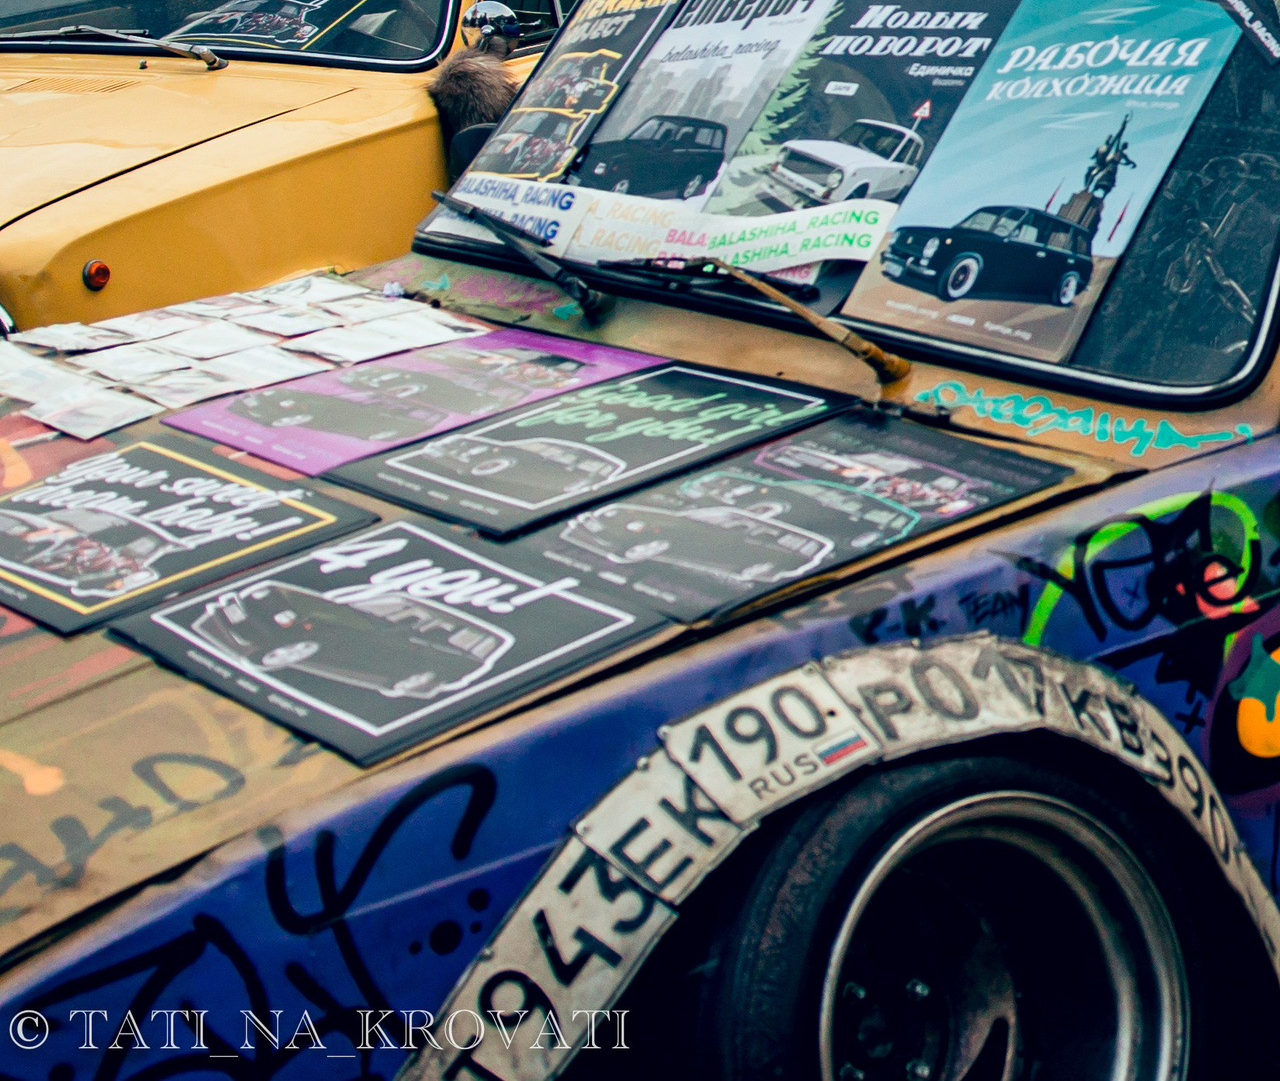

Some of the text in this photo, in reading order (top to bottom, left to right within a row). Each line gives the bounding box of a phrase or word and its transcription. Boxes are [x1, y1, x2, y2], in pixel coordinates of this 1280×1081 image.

[660, 39, 781, 62] balashiha_racing
[997, 34, 1211, 74] РАБОЧАЯ
[985, 72, 1194, 101] КОЛХОЗНИЦА
[707, 210, 879, 250] BALASHIHA_RACING
[688, 685, 829, 782] 190
[747, 755, 820, 801] RUS
